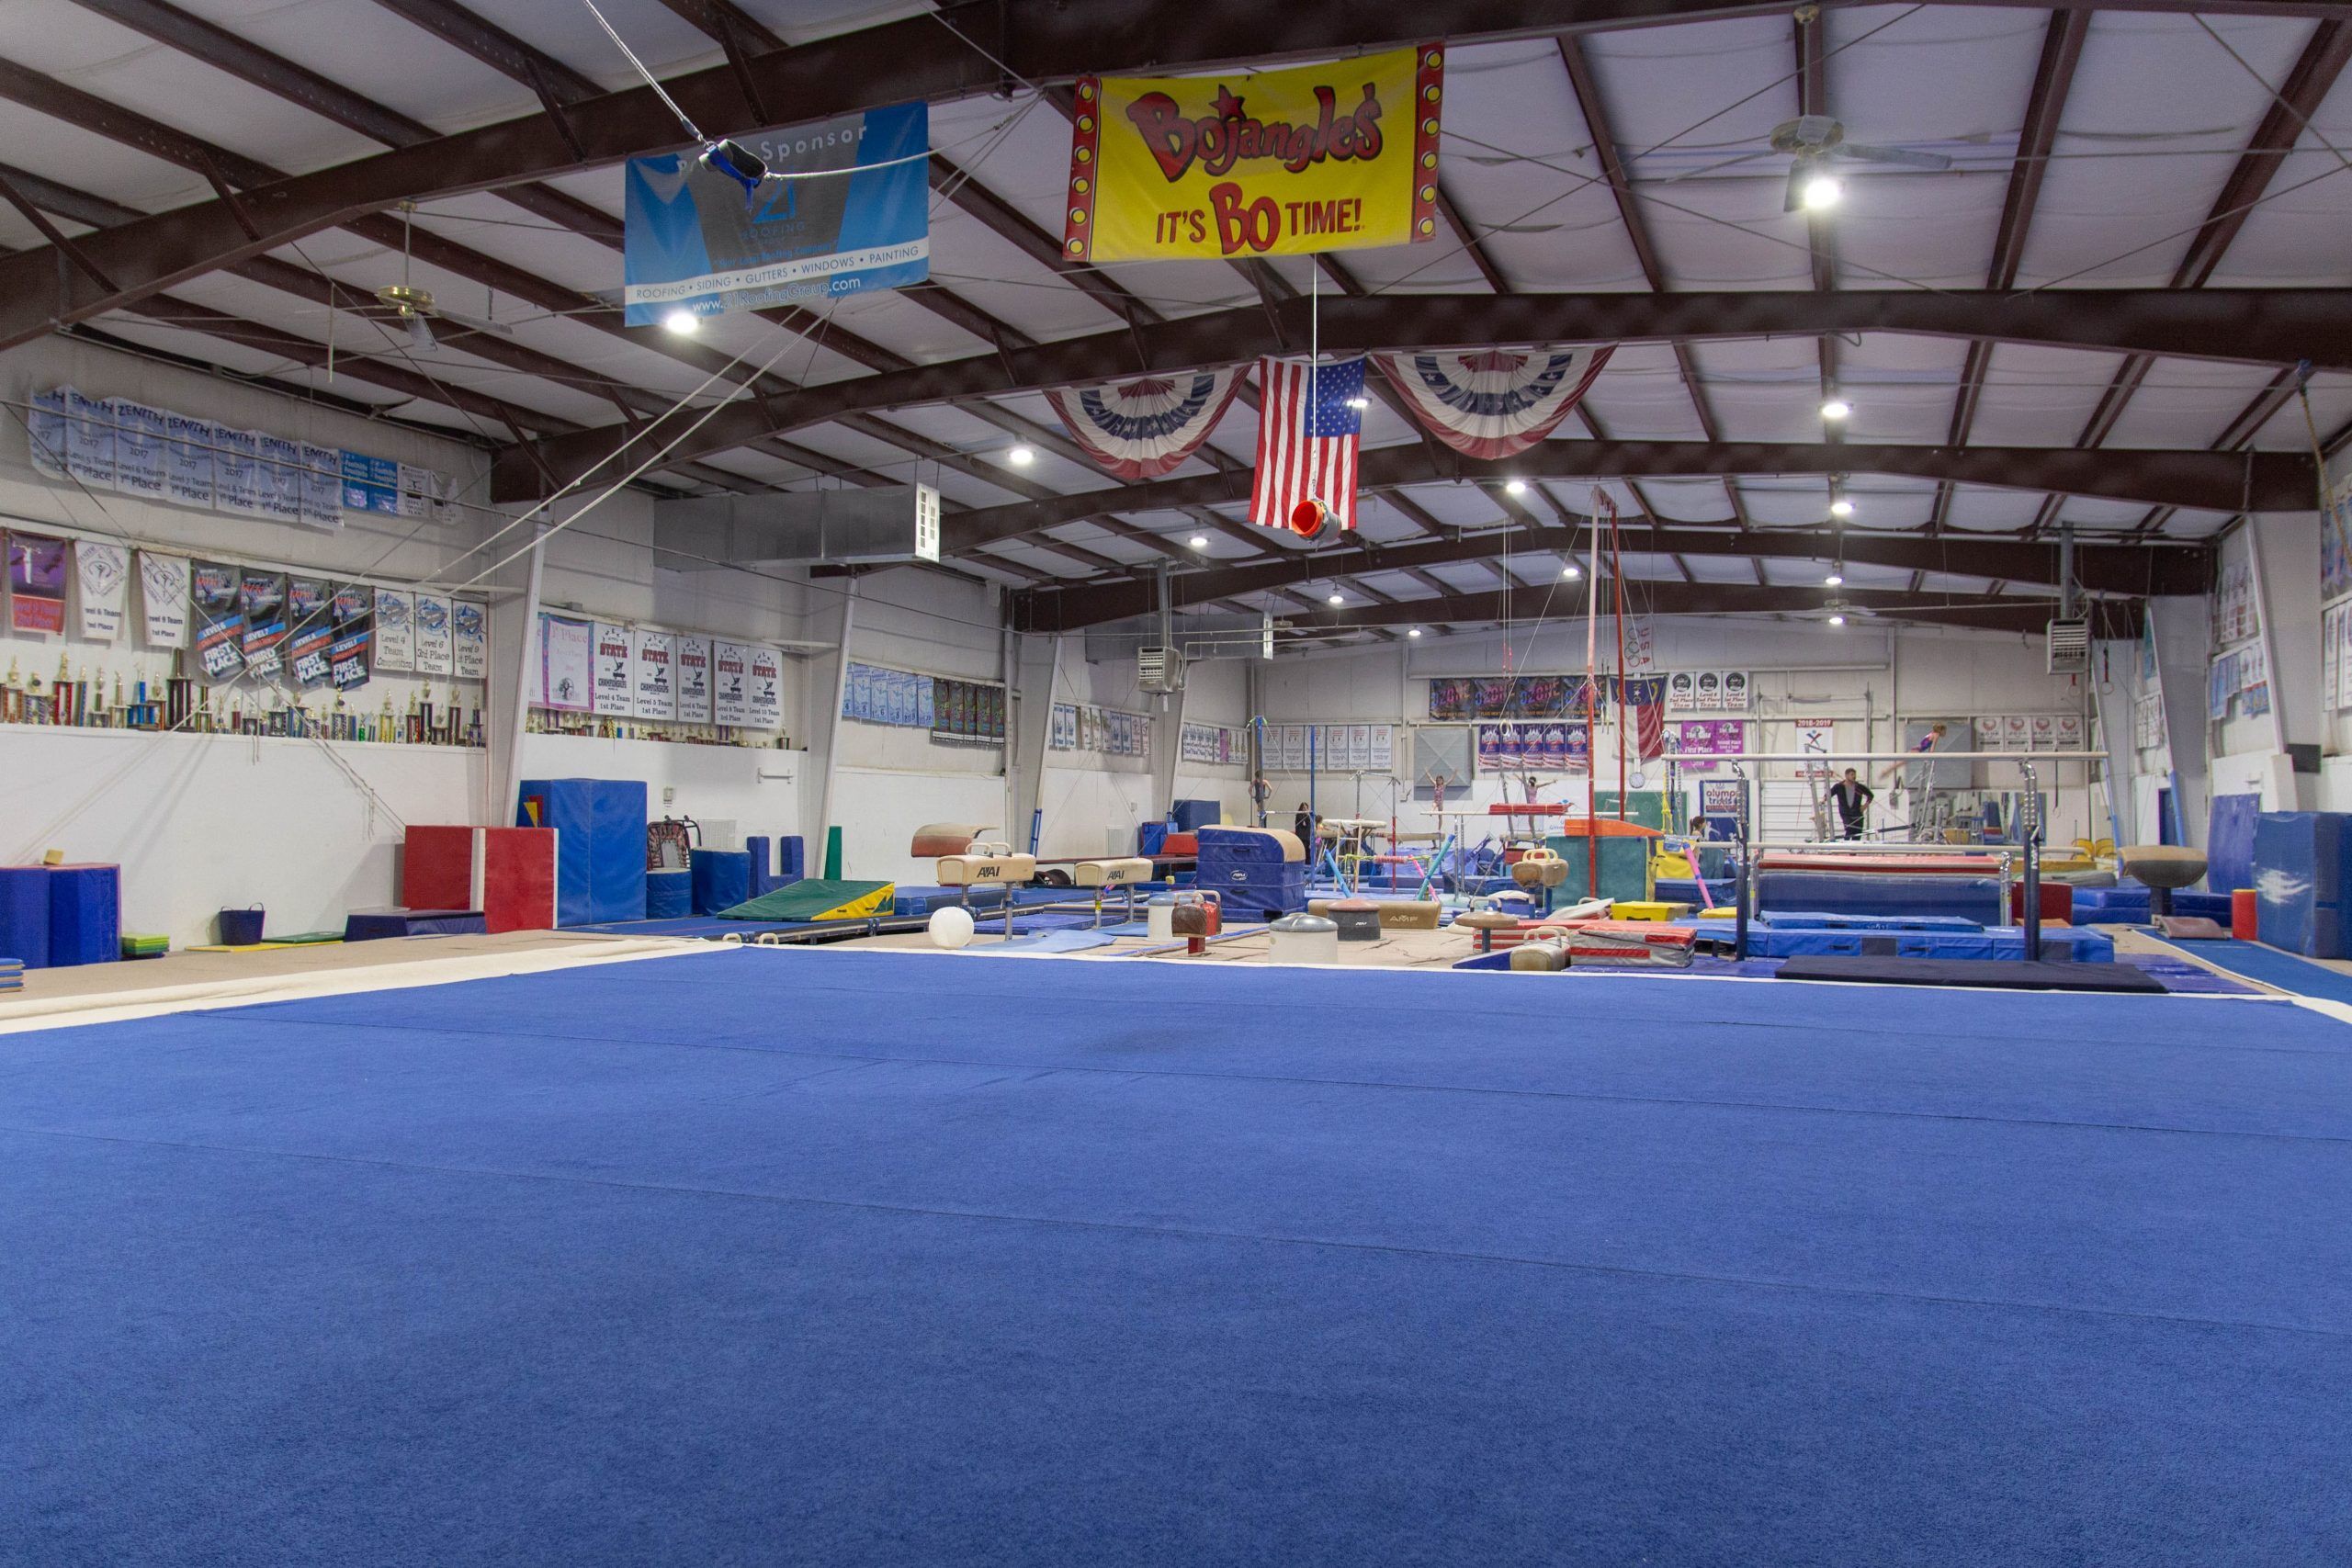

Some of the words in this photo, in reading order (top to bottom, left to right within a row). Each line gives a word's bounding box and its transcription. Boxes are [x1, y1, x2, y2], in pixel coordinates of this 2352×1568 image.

[761, 125, 867, 163] Sponsor
[1157, 209, 1205, 243] IT'S
[1209, 183, 1281, 254] BO
[1285, 198, 1362, 236] TIME!
[636, 285, 686, 299] ROOFING
[696, 276, 731, 291] SIDING
[745, 267, 788, 285] GUTTERS
[801, 256, 854, 274] WINDOWS
[869, 245, 919, 264] PAINTING
[693, 277, 862, 313] www.21RoofingGroup.com
[117, 404, 164, 425] ZENITH
[167, 416, 210, 437] ZENITH
[130, 446, 150, 458] 2017
[179, 458, 197, 470] 2017
[142, 467, 165, 478] Team
[225, 468, 243, 479] 2017
[131, 476, 162, 491] Place
[193, 477, 212, 487] Team
[183, 486, 209, 501] Place
[228, 494, 254, 509] Place
[273, 502, 299, 516] Place
[313, 510, 339, 524] Place
[104, 606, 121, 618] Team
[97, 622, 113, 631] Place
[167, 616, 183, 625] Team
[203, 624, 220, 637] LEVEL
[245, 629, 265, 641] LEVEL
[561, 628, 588, 643] Place
[295, 635, 311, 647] LEVEL
[336, 640, 354, 651] LEVEL
[382, 634, 399, 644] Level
[422, 639, 437, 649] Level
[204, 642, 231, 662] FIRST
[245, 647, 276, 663] THIRD
[383, 646, 404, 657] Team
[429, 649, 450, 660] Place
[458, 644, 473, 653] Level
[599, 642, 628, 659] STATE
[296, 652, 320, 671] FIRST
[464, 655, 483, 665] Place
[641, 649, 669, 664] STATE
[680, 653, 707, 669] STATE
[207, 651, 241, 676] PLACE
[250, 658, 281, 677] PLACE
[333, 657, 358, 674] FIRST
[424, 660, 443, 672] Team
[718, 660, 744, 674] STATE
[299, 660, 330, 682] PLACE
[334, 665, 367, 685] PLACE
[461, 665, 479, 676] Team
[752, 664, 776, 679] STATE
[594, 693, 610, 701] Level
[616, 694, 630, 703] Team
[1520, 682, 1560, 705] OZONE
[1565, 682, 1606, 705] OZOE
[610, 703, 625, 711] Place
[658, 699, 673, 707] Team
[732, 705, 745, 714] Team
[651, 707, 667, 716] Place
[1706, 788, 1736, 799] olymp
[1389, 914, 1419, 923] AMF
